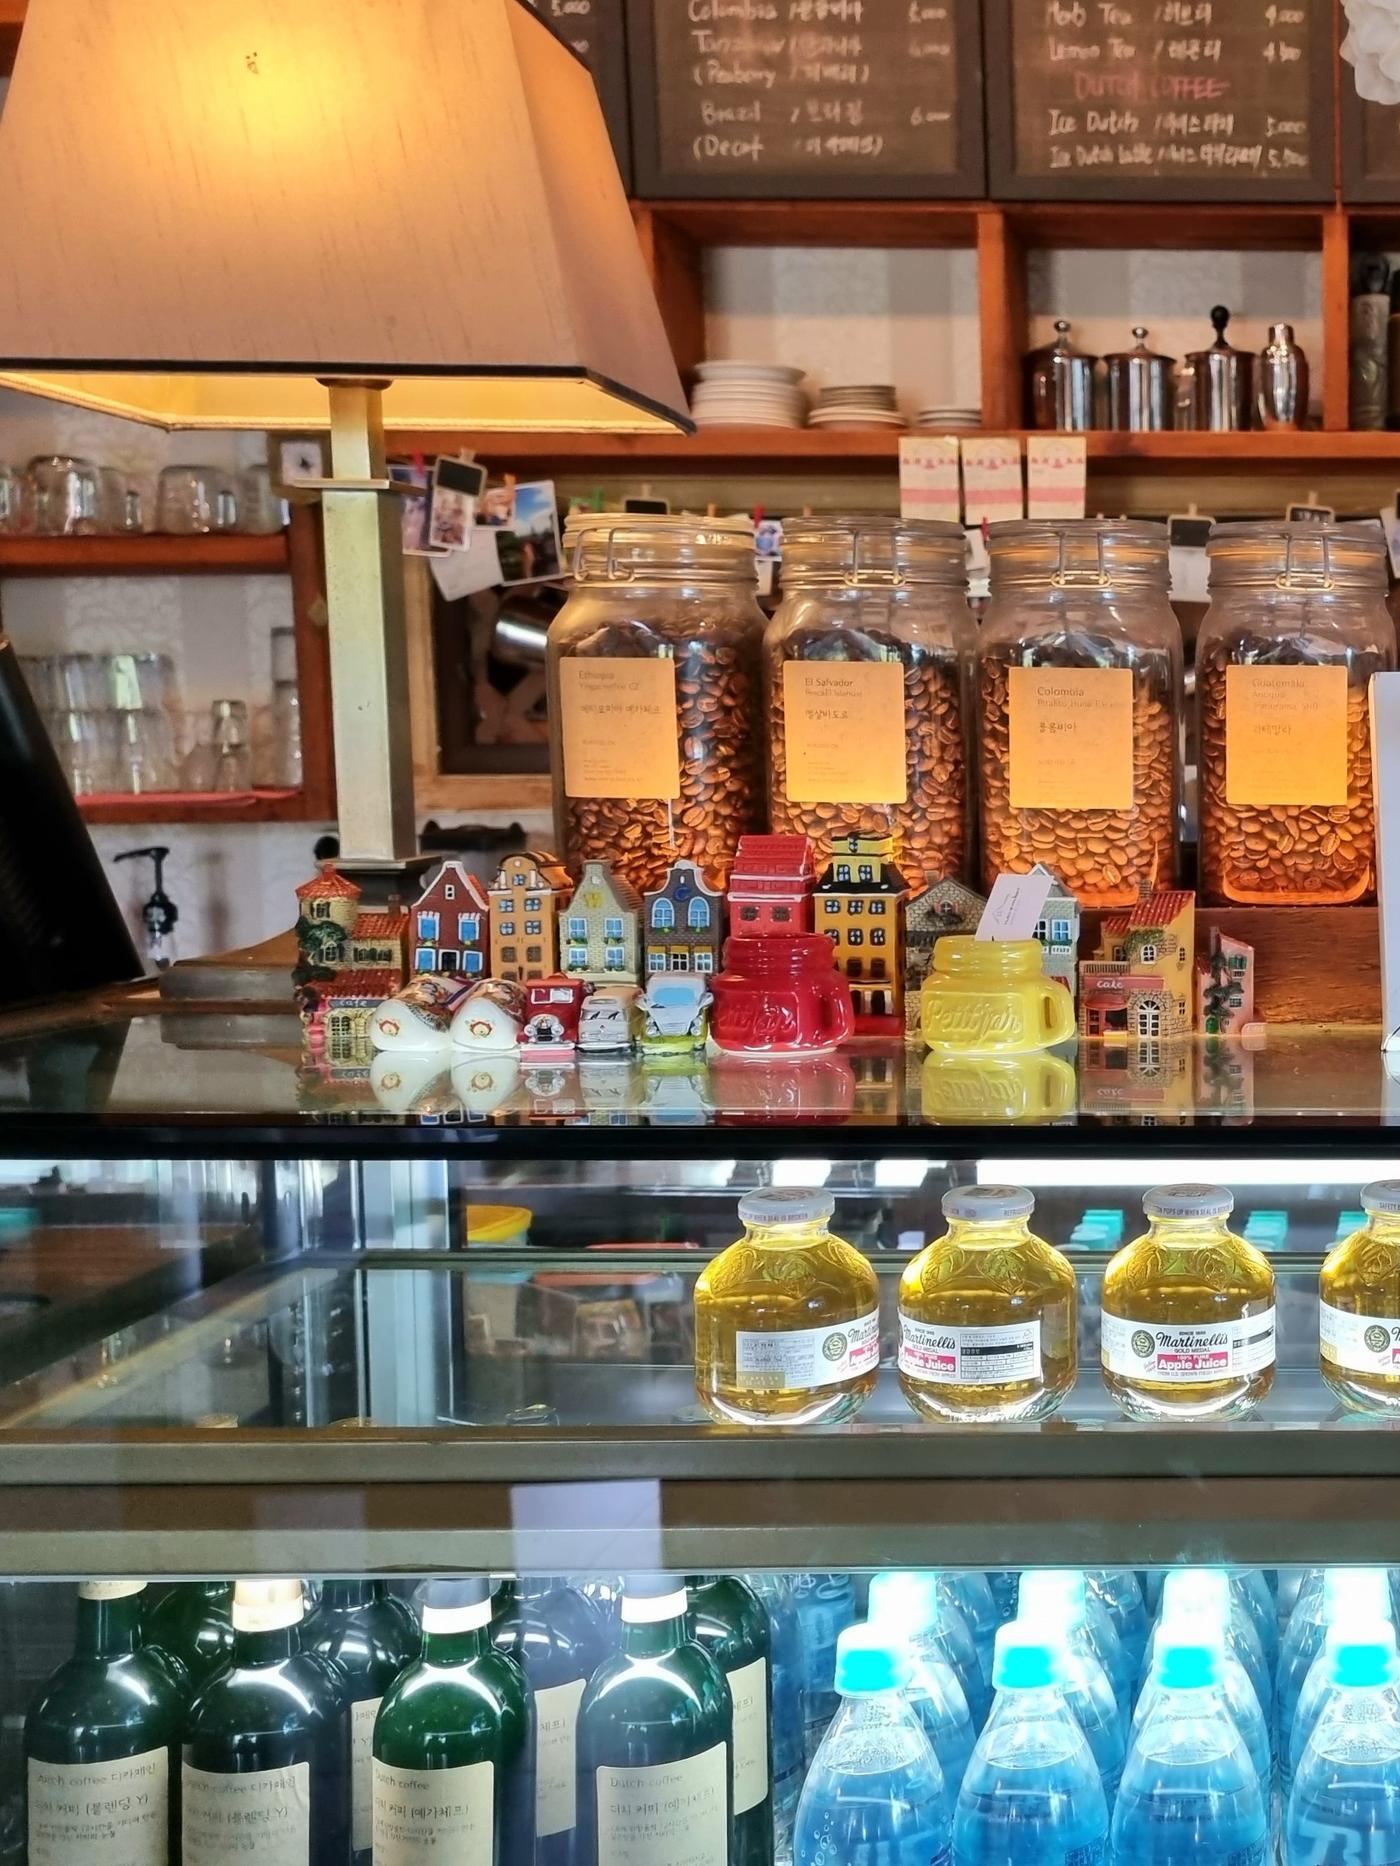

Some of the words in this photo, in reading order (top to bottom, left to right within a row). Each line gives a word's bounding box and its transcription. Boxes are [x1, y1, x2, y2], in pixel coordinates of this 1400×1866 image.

[805, 678, 813, 687] El
[816, 678, 854, 687] Salvador
[1037, 687, 1084, 696] Colombia
[926, 1358, 955, 1371] Juice
[1158, 1359, 1193, 1371] Apple
[1194, 1358, 1227, 1369] Juice
[611, 1776, 644, 1788] Dutch
